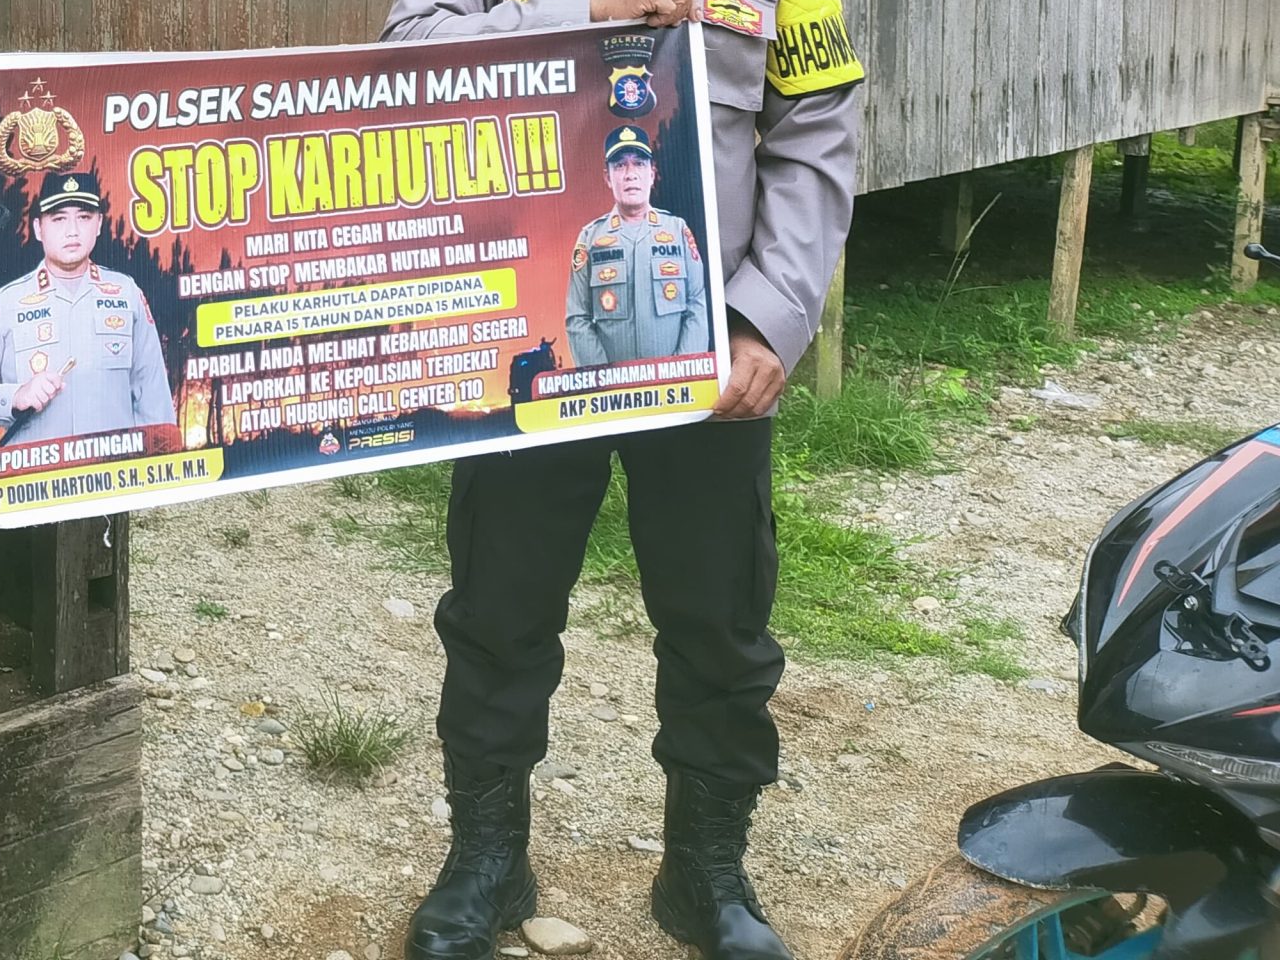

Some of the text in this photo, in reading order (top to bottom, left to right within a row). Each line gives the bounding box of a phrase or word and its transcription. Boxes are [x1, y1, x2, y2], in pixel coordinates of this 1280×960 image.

[104, 59, 576, 133] POLSEK SANAMAN MANTIKEI
[130, 141, 262, 234] STOP
[267, 120, 509, 218] KARHUTLA
[245, 214, 464, 258] MARI KITA CEGAH KARHUTLA
[651, 245, 682, 257] POLRI
[179, 237, 529, 297] DENGAN STOP MEMBAKAR HUTAN DAN LAHAN
[17, 306, 52, 323] DODIK
[96, 298, 128, 310] POLRI
[215, 292, 500, 340] PENJARA 15 TAHUN DAN DENDA 15 MILYAR
[234, 277, 483, 319] PELAKU KARHUTLA DAPAT DIPIDANA
[186, 316, 529, 381] APABILA ANDA MELIHAT KEBAKARAN SEGERA
[221, 348, 499, 405] LAPORKAN KE KEPOLISIAN TERDEKAT
[538, 356, 715, 395] KAPOLSEK SANAMAN MANTIKEI
[240, 406, 281, 433] ATAU
[286, 396, 354, 426] HUBUNGI
[358, 390, 396, 415] CALL
[399, 382, 455, 410] CENTER
[458, 378, 484, 401] 110
[559, 386, 694, 419] AKP SUWARDI, S.H.
[63, 431, 144, 462] KATINGAN
[348, 429, 415, 451] PRESISI
[7, 481, 50, 506] DODIK
[51, 471, 116, 499] HARTONO,
[182, 457, 209, 480] M.H.
